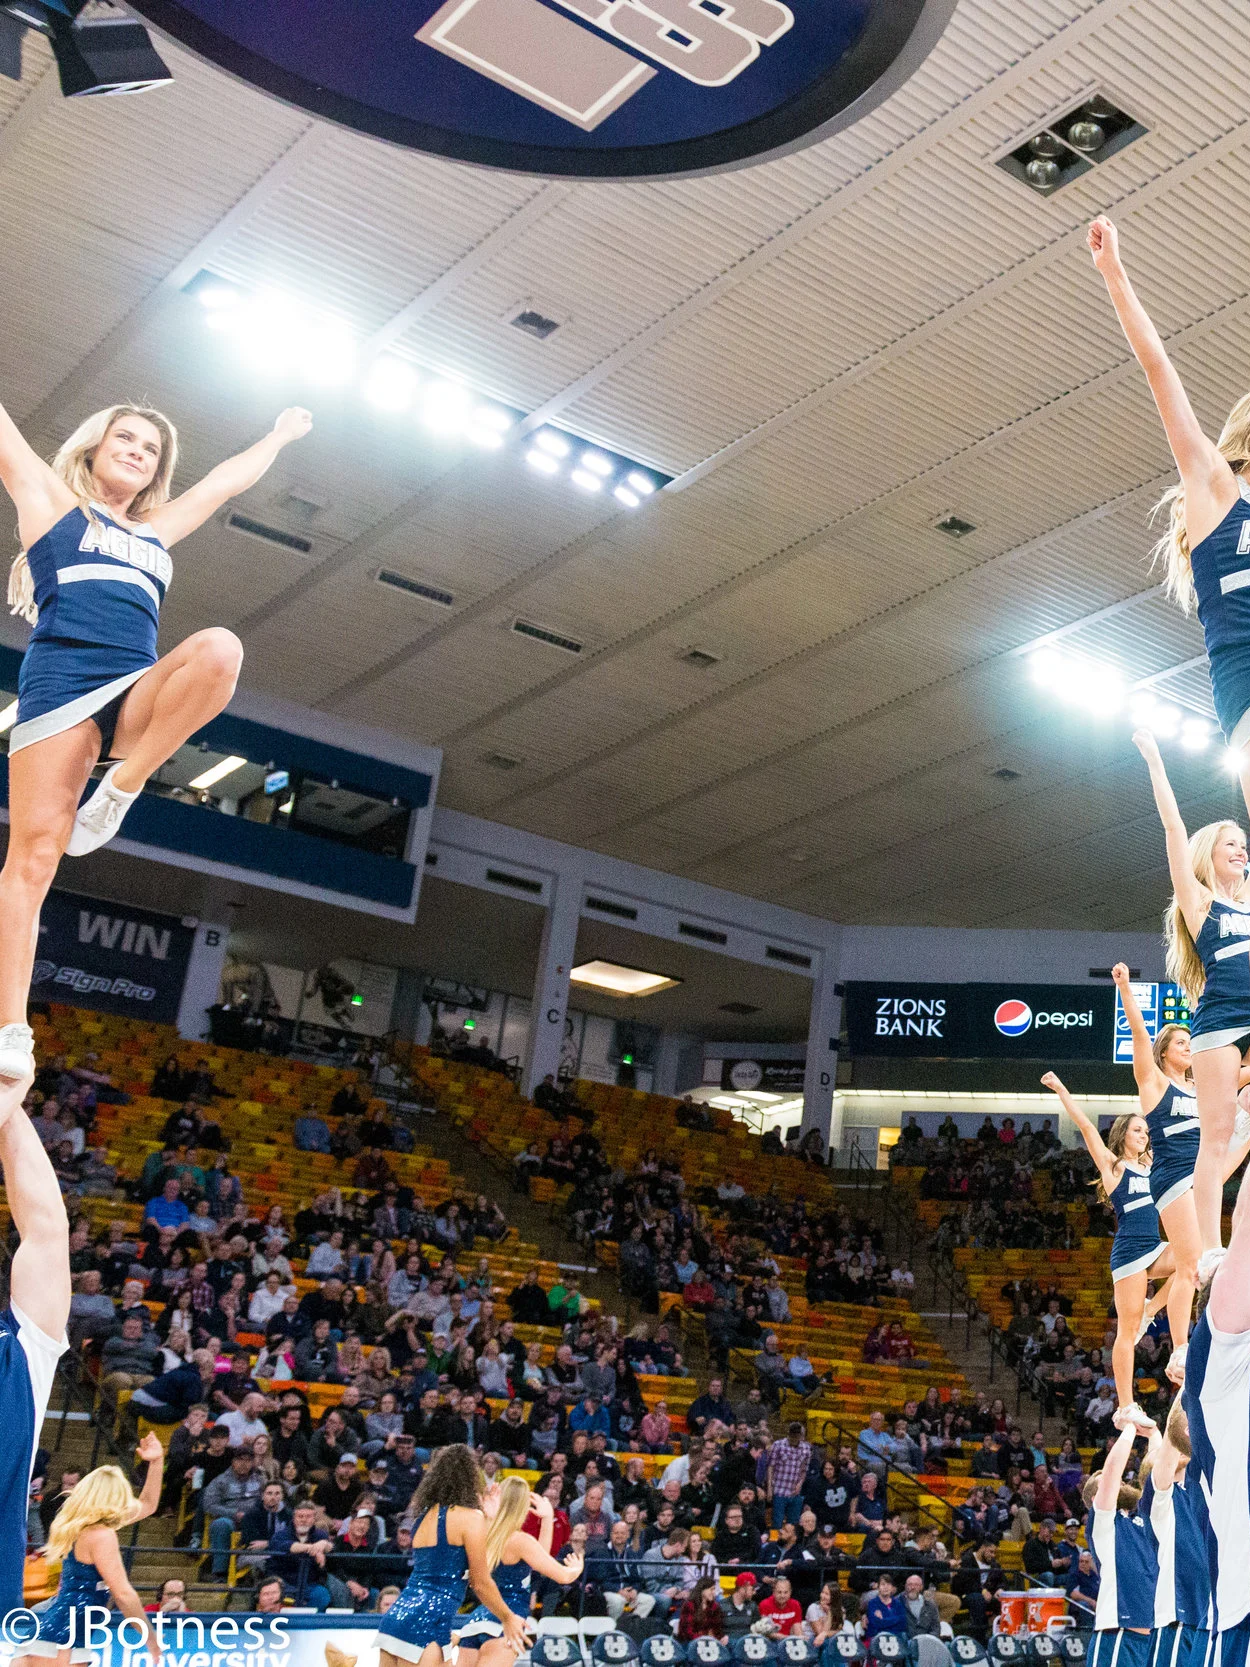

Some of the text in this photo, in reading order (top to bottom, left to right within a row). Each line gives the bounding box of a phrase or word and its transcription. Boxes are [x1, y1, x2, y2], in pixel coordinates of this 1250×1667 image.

[79, 911, 173, 960] WIN
[205, 931, 220, 947] B
[54, 967, 157, 1001] Sign Pro
[547, 1008, 560, 1024] C
[875, 998, 947, 1017] ZIONS
[874, 1017, 944, 1038] BANK
[1035, 1010, 1093, 1029] pepsi
[820, 1072, 830, 1085] D
